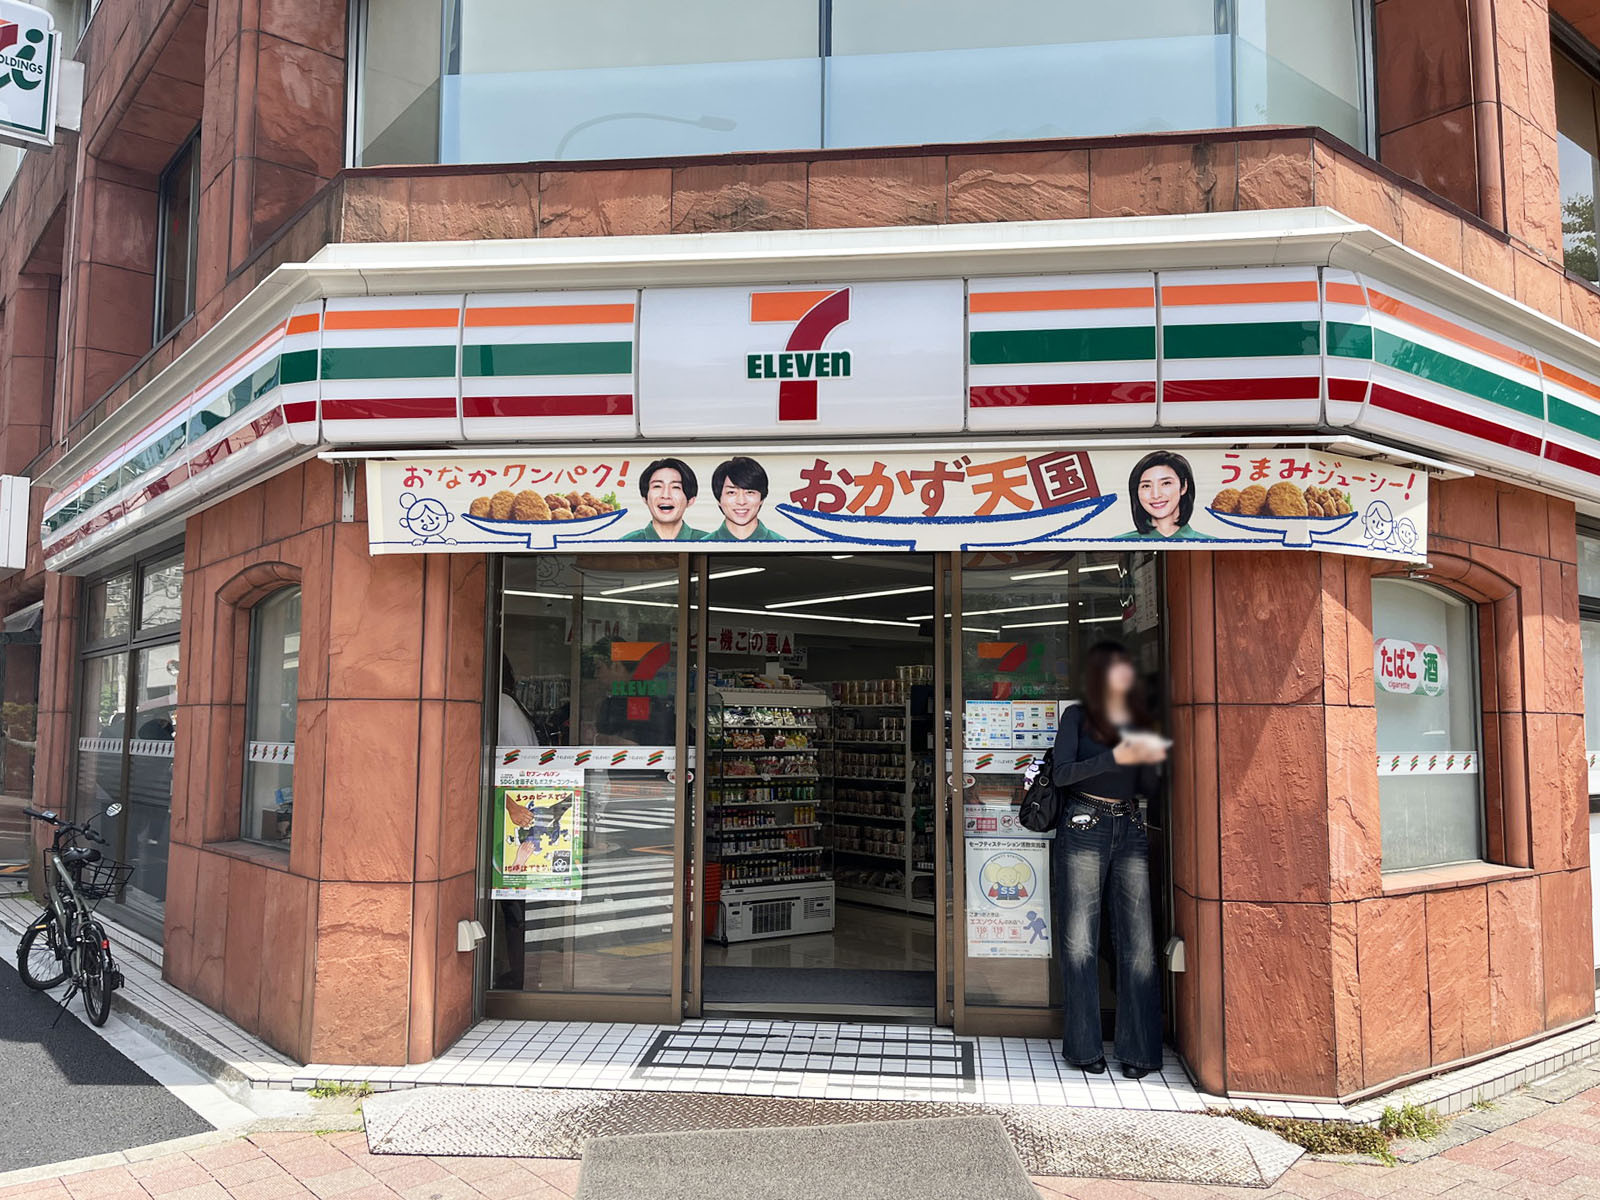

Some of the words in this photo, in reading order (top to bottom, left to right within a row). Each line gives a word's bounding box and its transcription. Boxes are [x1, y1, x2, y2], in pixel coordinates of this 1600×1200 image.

[0, 54, 43, 75] OLDINGS
[402, 461, 630, 488] おなかワンパク!
[790, 451, 1101, 517] おかず天国
[1221, 453, 1416, 501] うまみジューシー!
[1381, 645, 1417, 679] たばこ
[1423, 652, 1438, 683] 酒
[1001, 886, 1016, 895] SS
